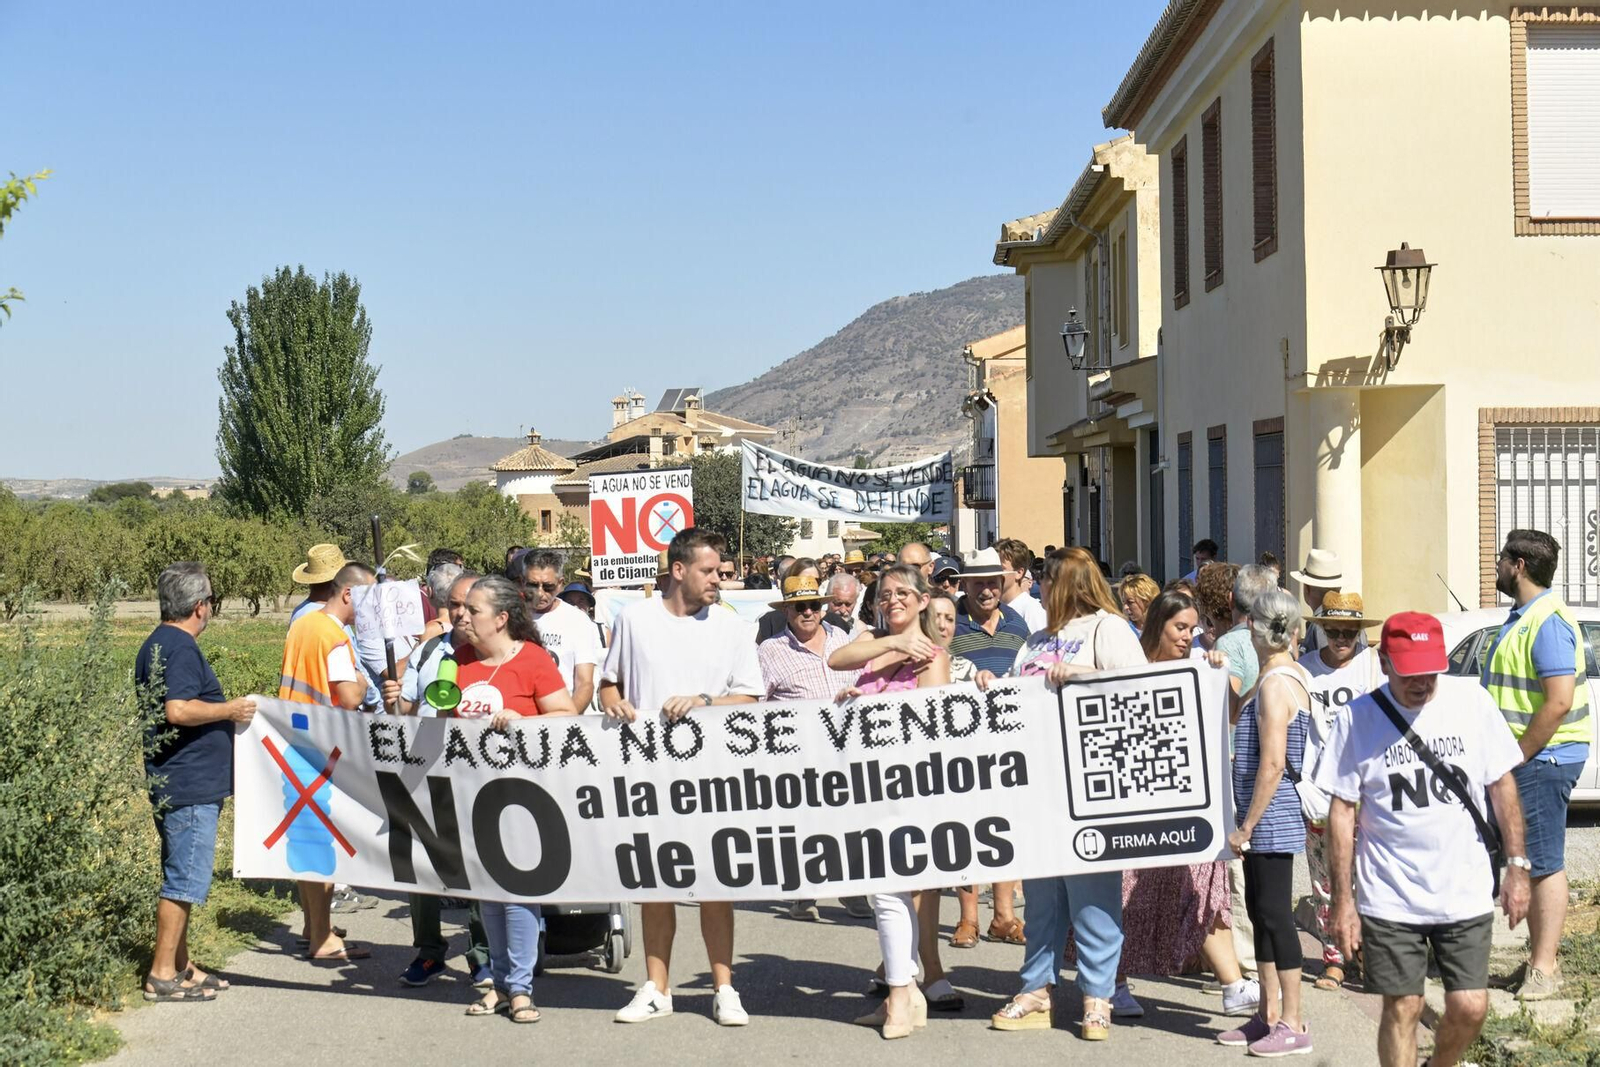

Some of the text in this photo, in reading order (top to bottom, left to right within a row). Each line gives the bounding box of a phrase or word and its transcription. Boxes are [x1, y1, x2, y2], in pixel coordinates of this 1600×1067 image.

[602, 478, 630, 493] AGUA
[632, 476, 647, 491] NO
[649, 475, 661, 489] SE
[664, 473, 692, 489] VEND
[756, 450, 953, 488] EL AGUA NO SE VENDE
[747, 476, 945, 515] EL AGUA SE DEFIENDE
[591, 493, 694, 556] NO
[599, 566, 657, 580] de Cijanc
[600, 558, 609, 566] la
[610, 555, 658, 566] embotellad
[372, 586, 400, 605] NO
[374, 600, 415, 621] ROBO
[1411, 632, 1428, 641] GAES
[368, 686, 1025, 770] EL AGUA NO SE VENDE
[1384, 735, 1466, 768] EMBOTADORA
[1388, 763, 1468, 811] NO
[375, 750, 1029, 897] NO a la embotelladora
[1112, 826, 1196, 849] FIRMA AQUÍ
[615, 816, 1014, 892] de Cijancos
